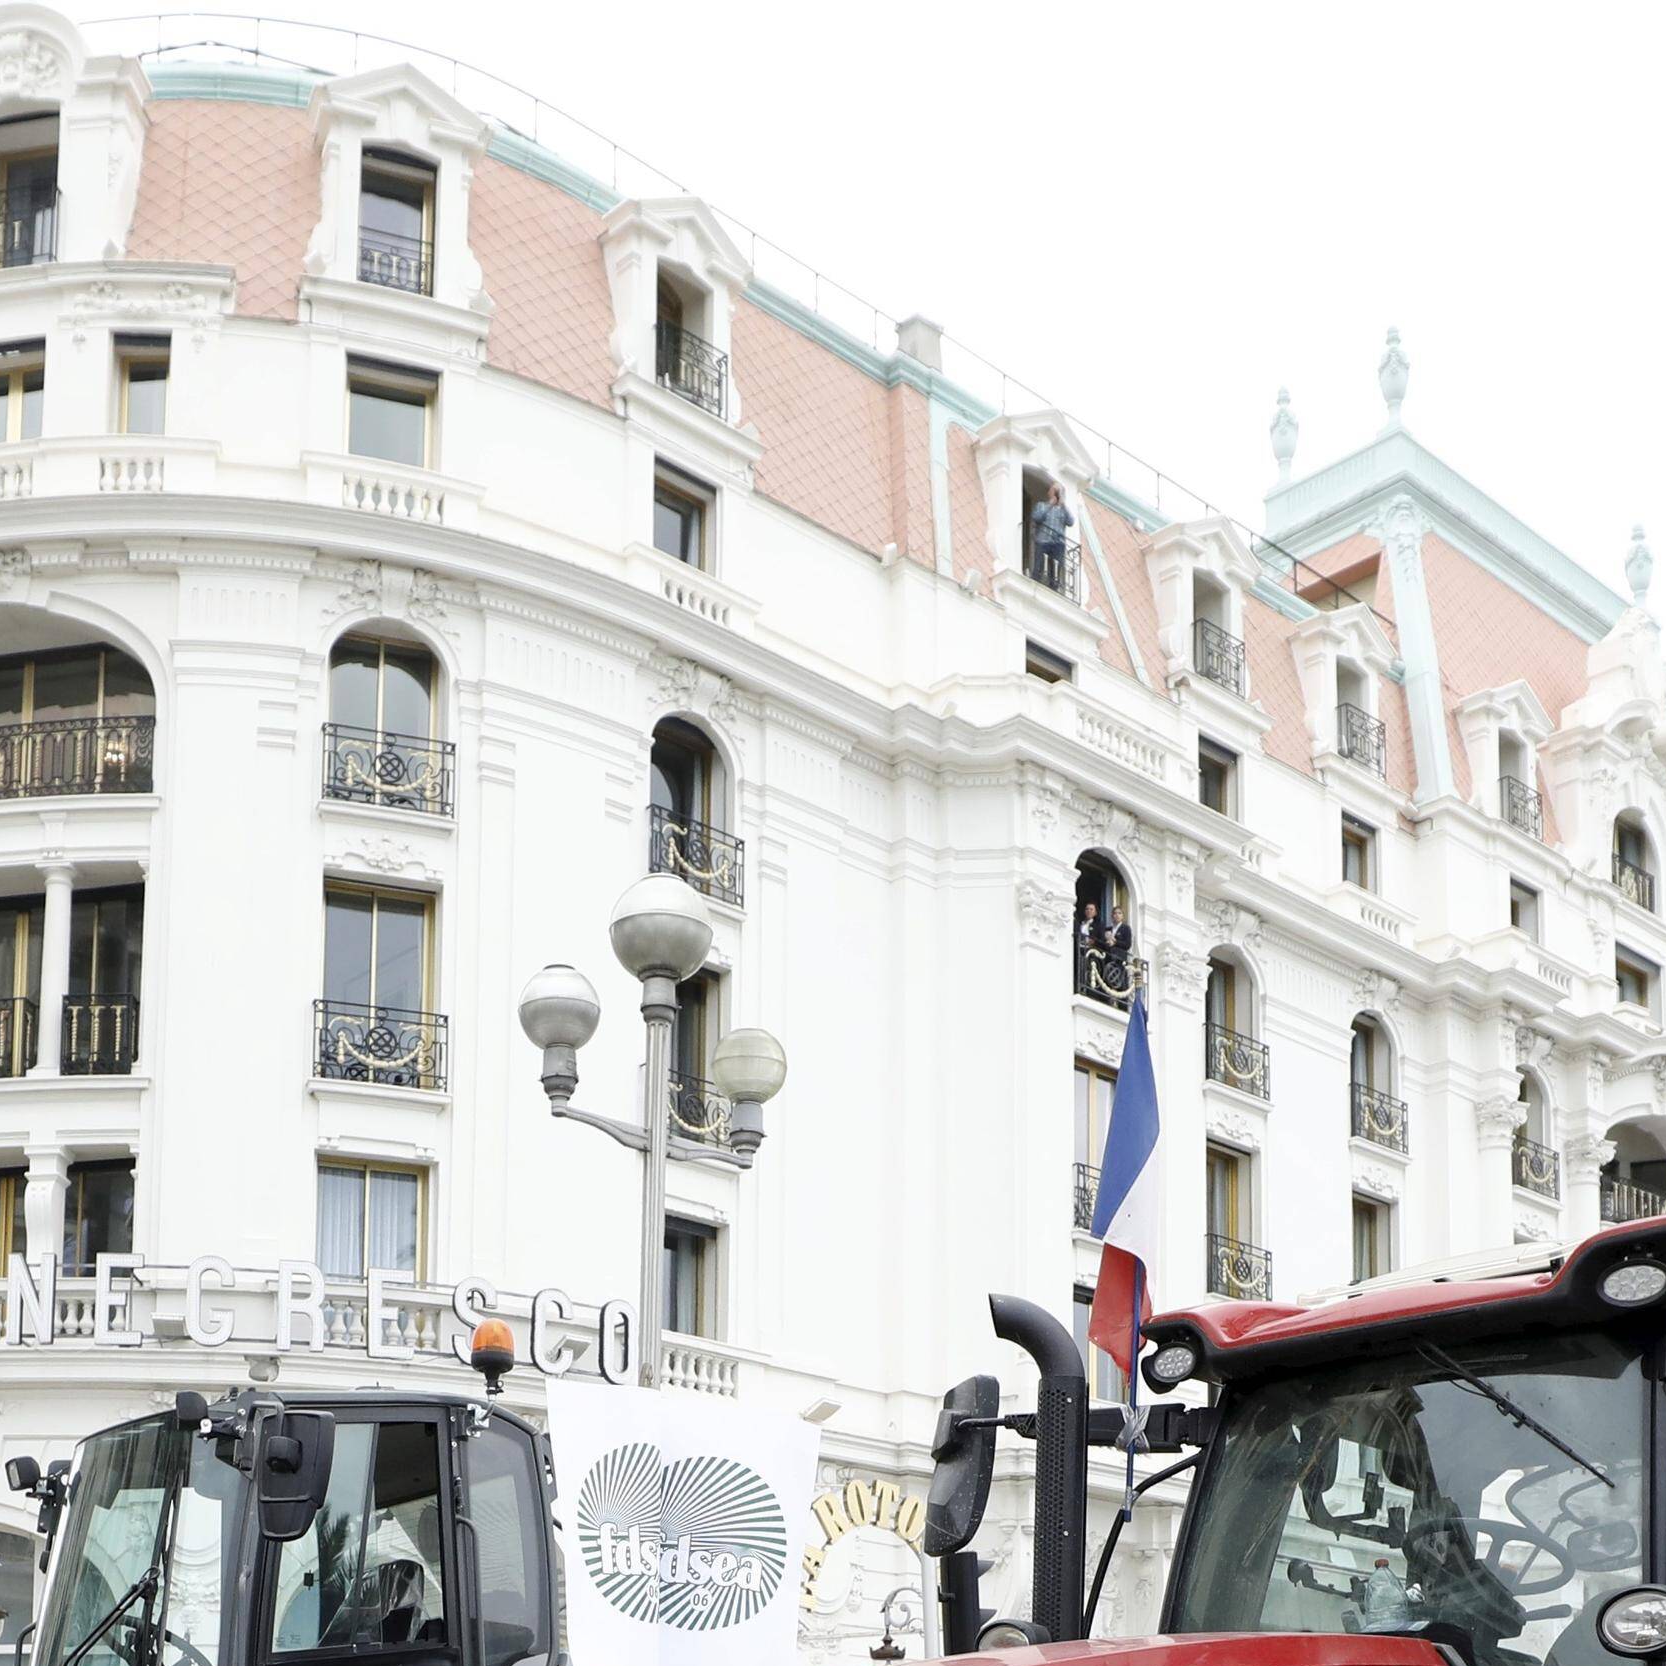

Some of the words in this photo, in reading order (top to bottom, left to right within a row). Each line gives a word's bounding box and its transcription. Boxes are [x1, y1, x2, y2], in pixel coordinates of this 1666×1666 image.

[6, 1252, 638, 1386] NEGRESCO
[811, 1479, 927, 1545] ROTO
[660, 1531, 763, 1593] dsea
[692, 1592, 709, 1608] 06
